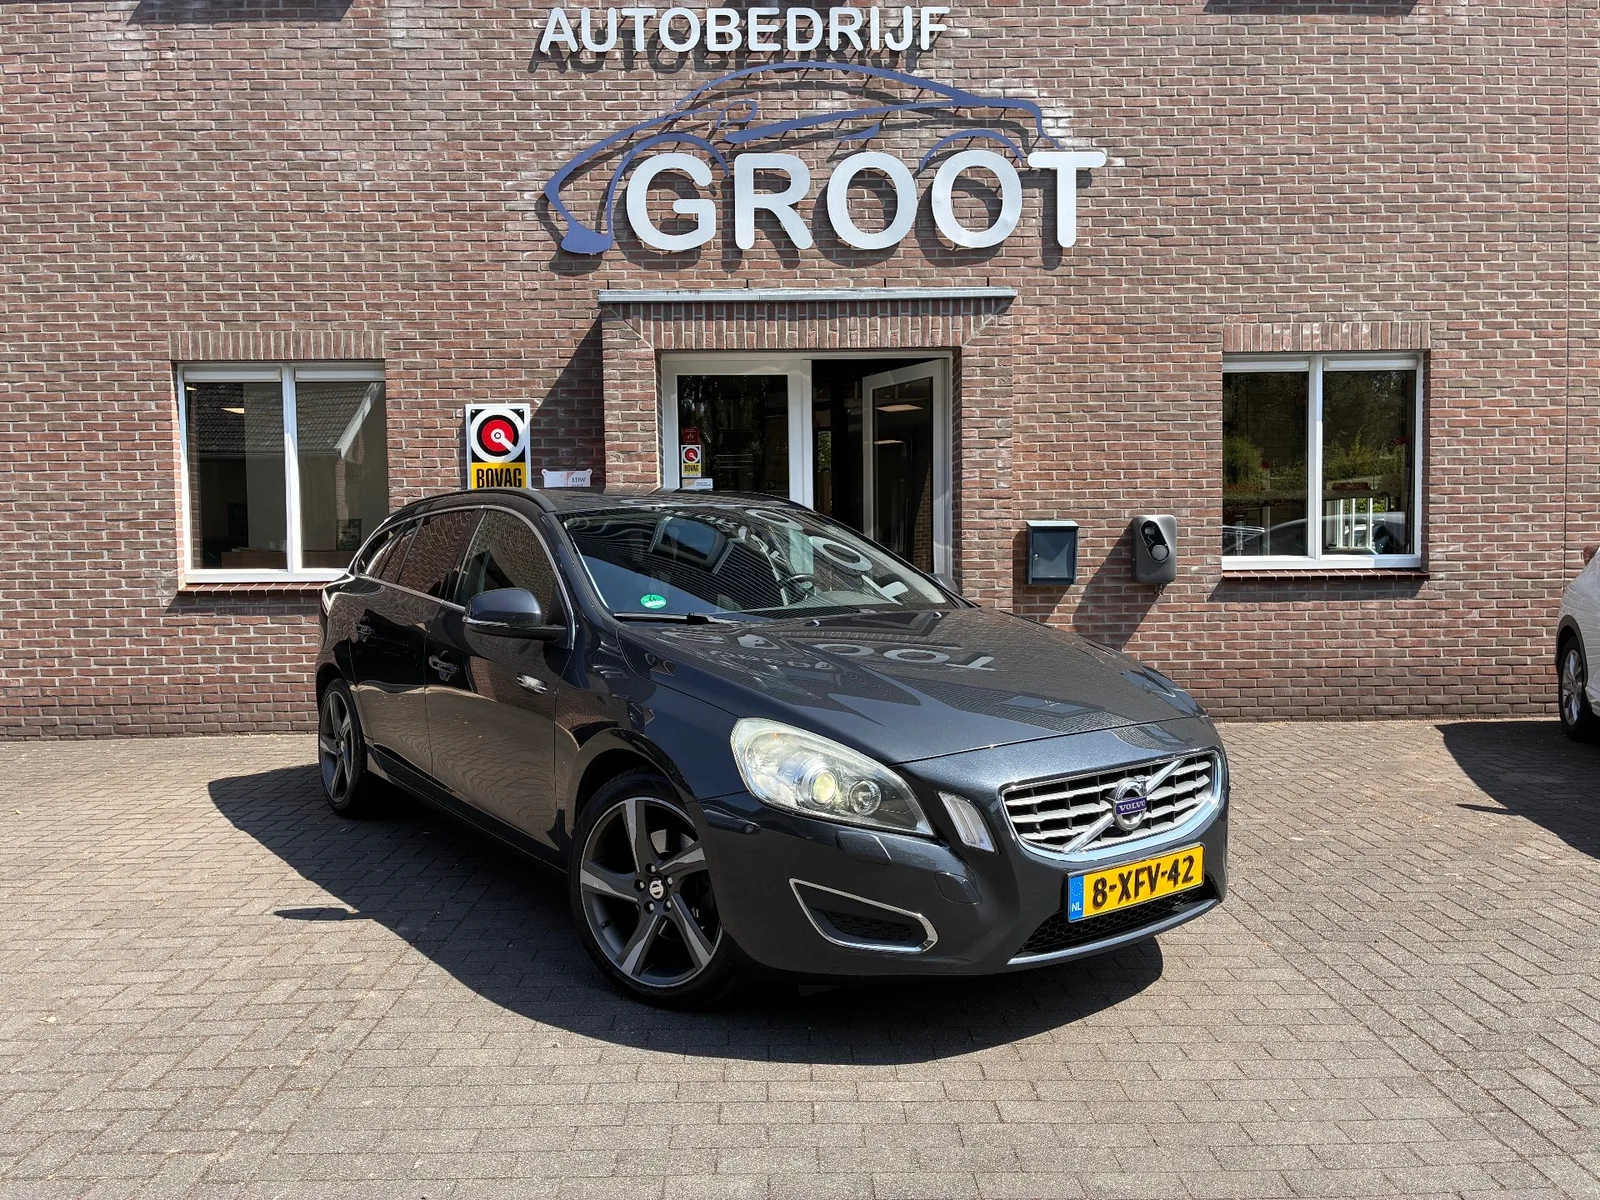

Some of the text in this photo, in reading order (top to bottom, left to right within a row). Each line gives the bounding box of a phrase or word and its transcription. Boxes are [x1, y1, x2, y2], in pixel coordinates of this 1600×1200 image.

[539, 6, 950, 53] AUTOBEDRIJF
[626, 148, 1107, 251] GROOT
[476, 467, 523, 488] BOVAG
[684, 464, 700, 472] BOVAG
[1118, 799, 1146, 812] VOLVO
[1092, 855, 1194, 911] 8-XFV-42
[1071, 902, 1082, 912] NL
